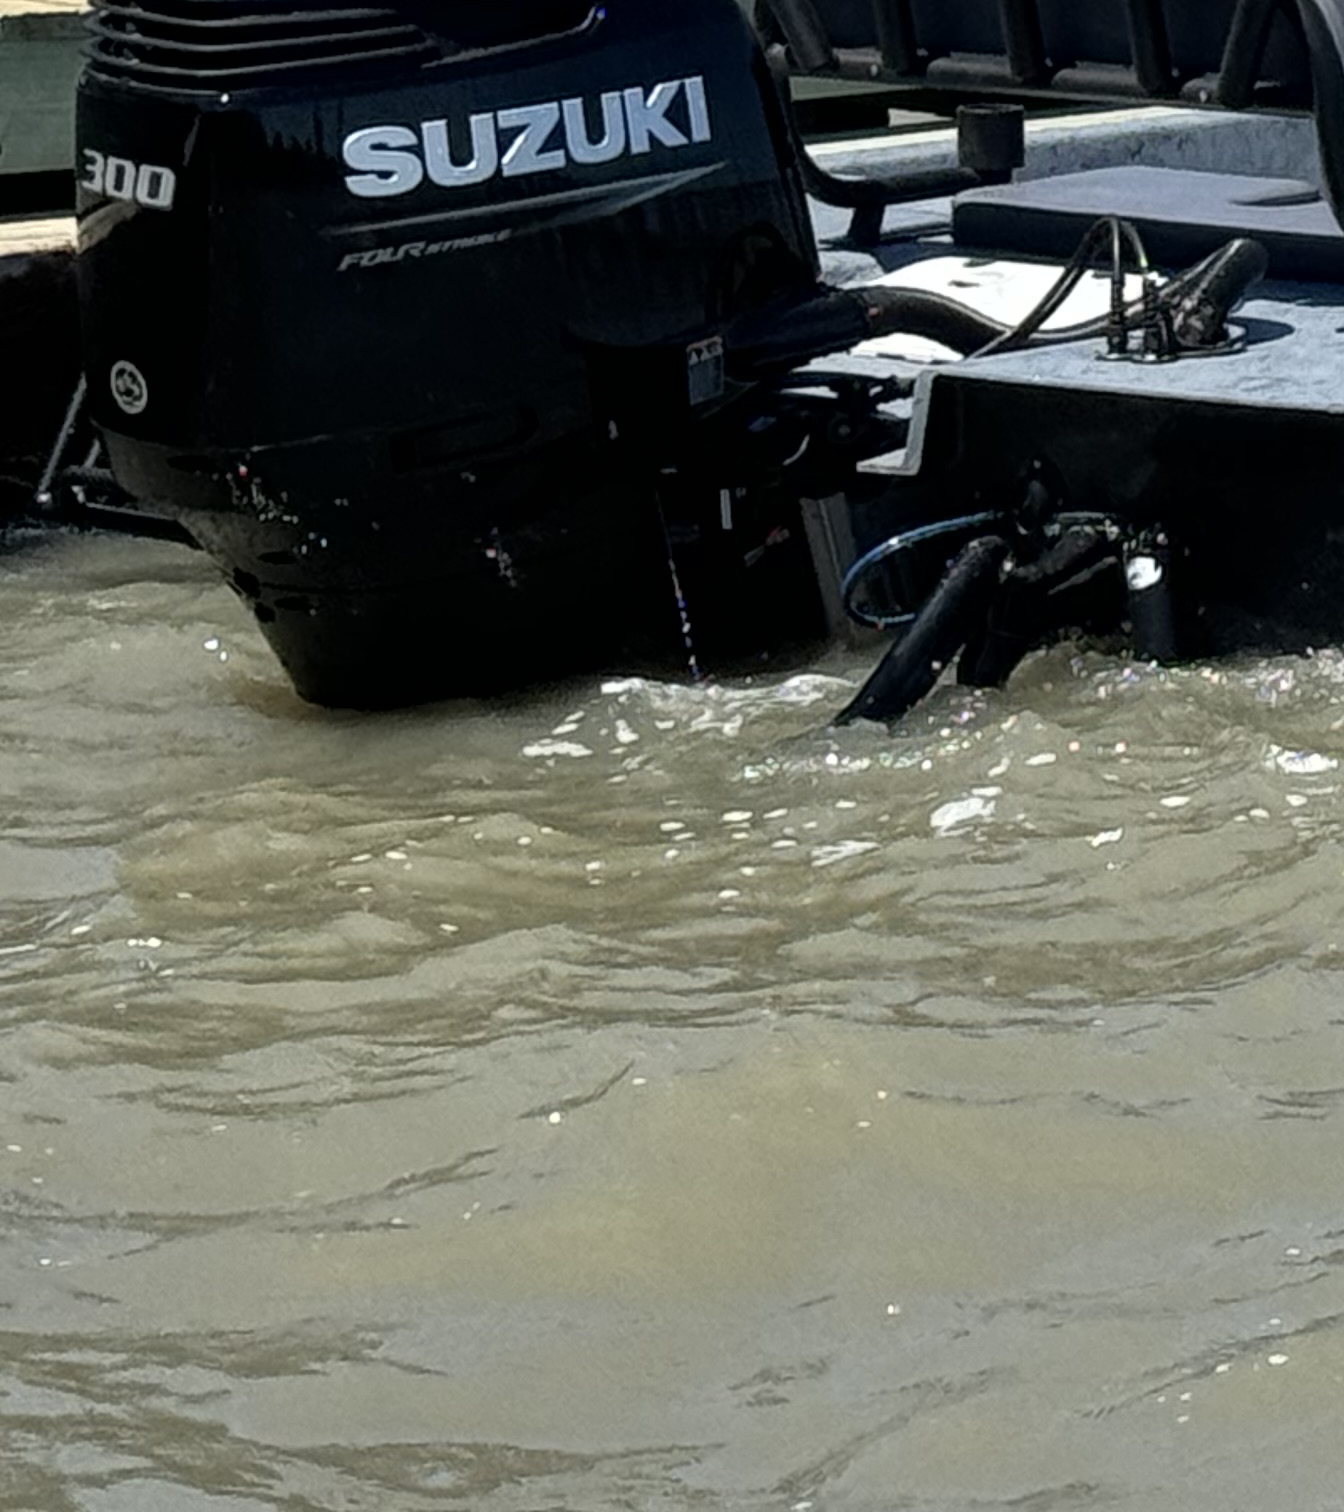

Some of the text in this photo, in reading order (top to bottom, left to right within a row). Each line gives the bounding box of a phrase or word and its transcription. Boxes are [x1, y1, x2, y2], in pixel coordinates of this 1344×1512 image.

[341, 75, 712, 199] SUZUKI
[81, 148, 177, 209] 300
[336, 241, 427, 273] FOUR
